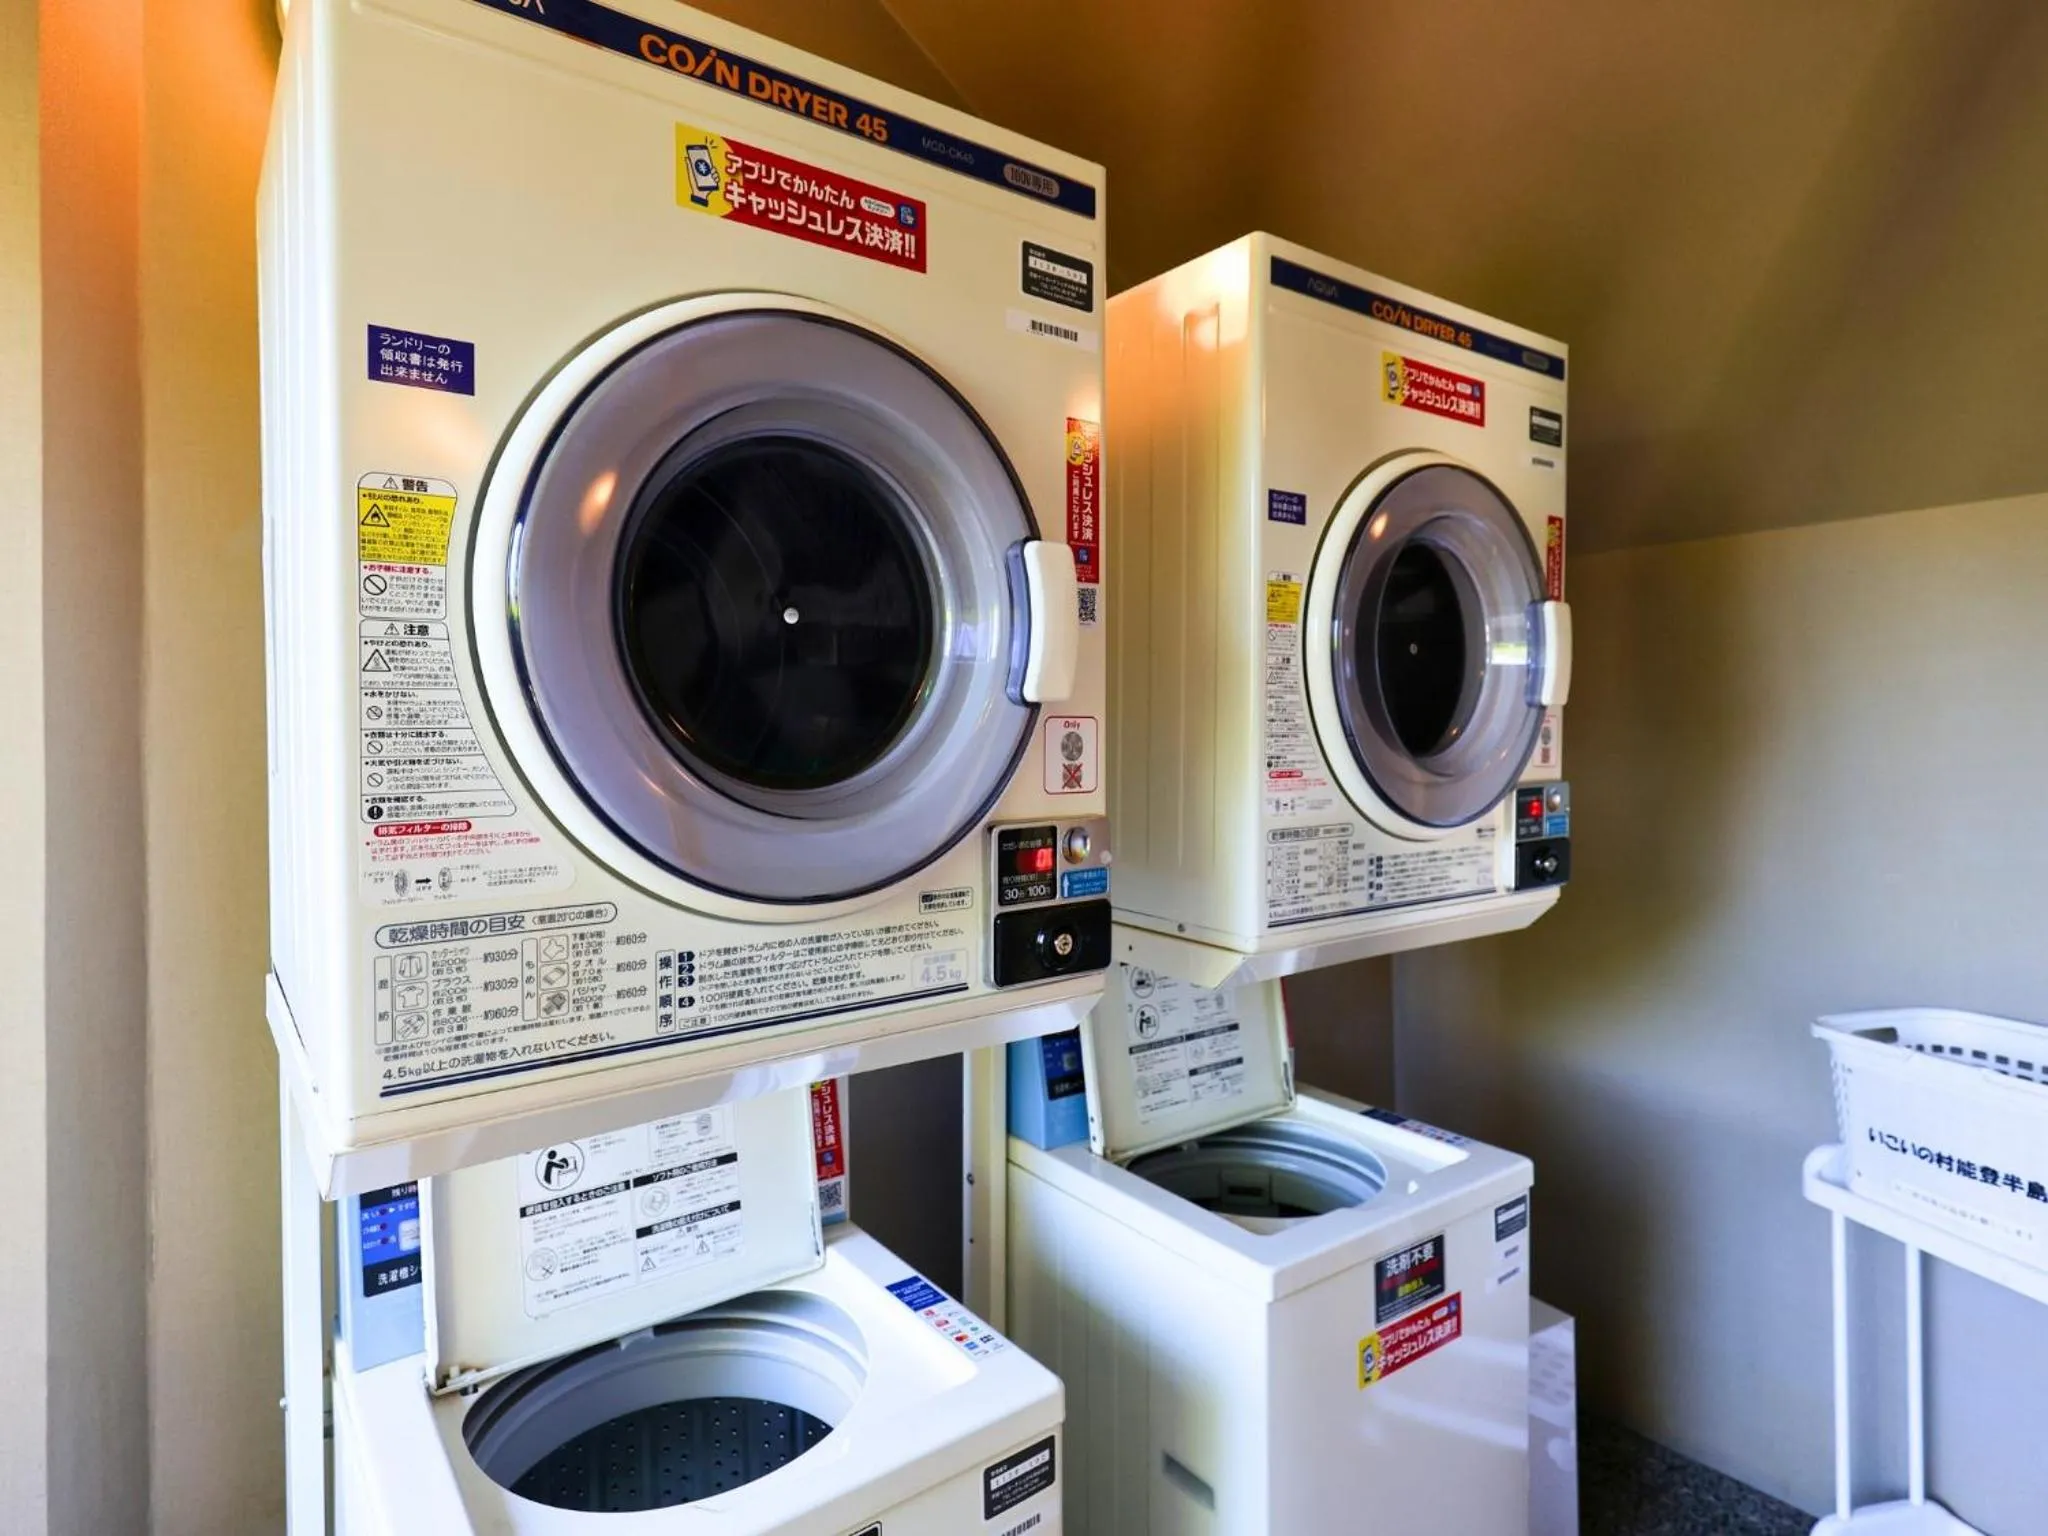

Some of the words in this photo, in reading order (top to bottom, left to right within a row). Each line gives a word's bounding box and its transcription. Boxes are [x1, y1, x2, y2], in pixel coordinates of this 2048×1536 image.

[748, 70, 848, 128] DRYER
[855, 113, 889, 142] 45
[724, 154, 856, 210] アプリでかんたん
[380, 333, 451, 355] ランドリーの
[1413, 314, 1456, 343] DRYER
[1457, 330, 1473, 349] 45
[380, 348, 464, 373] 領収書は発行
[380, 364, 448, 385] 出来ません
[403, 624, 430, 636] 注意
[389, 915, 525, 943] 乾燥時間の目安
[616, 932, 648, 946] 約60分
[483, 948, 518, 963] 約30分
[616, 959, 648, 973] 約60分
[483, 977, 519, 992] 約30分
[616, 985, 648, 1000] 約60分
[659, 955, 672, 1028] 操作順序
[382, 1031, 616, 1081] 4.5kg以上の洗濯物を入れないでください。
[1868, 1127, 2048, 1204] いこいの村能登半島
[1386, 1241, 1435, 1277] 洗剤不要
